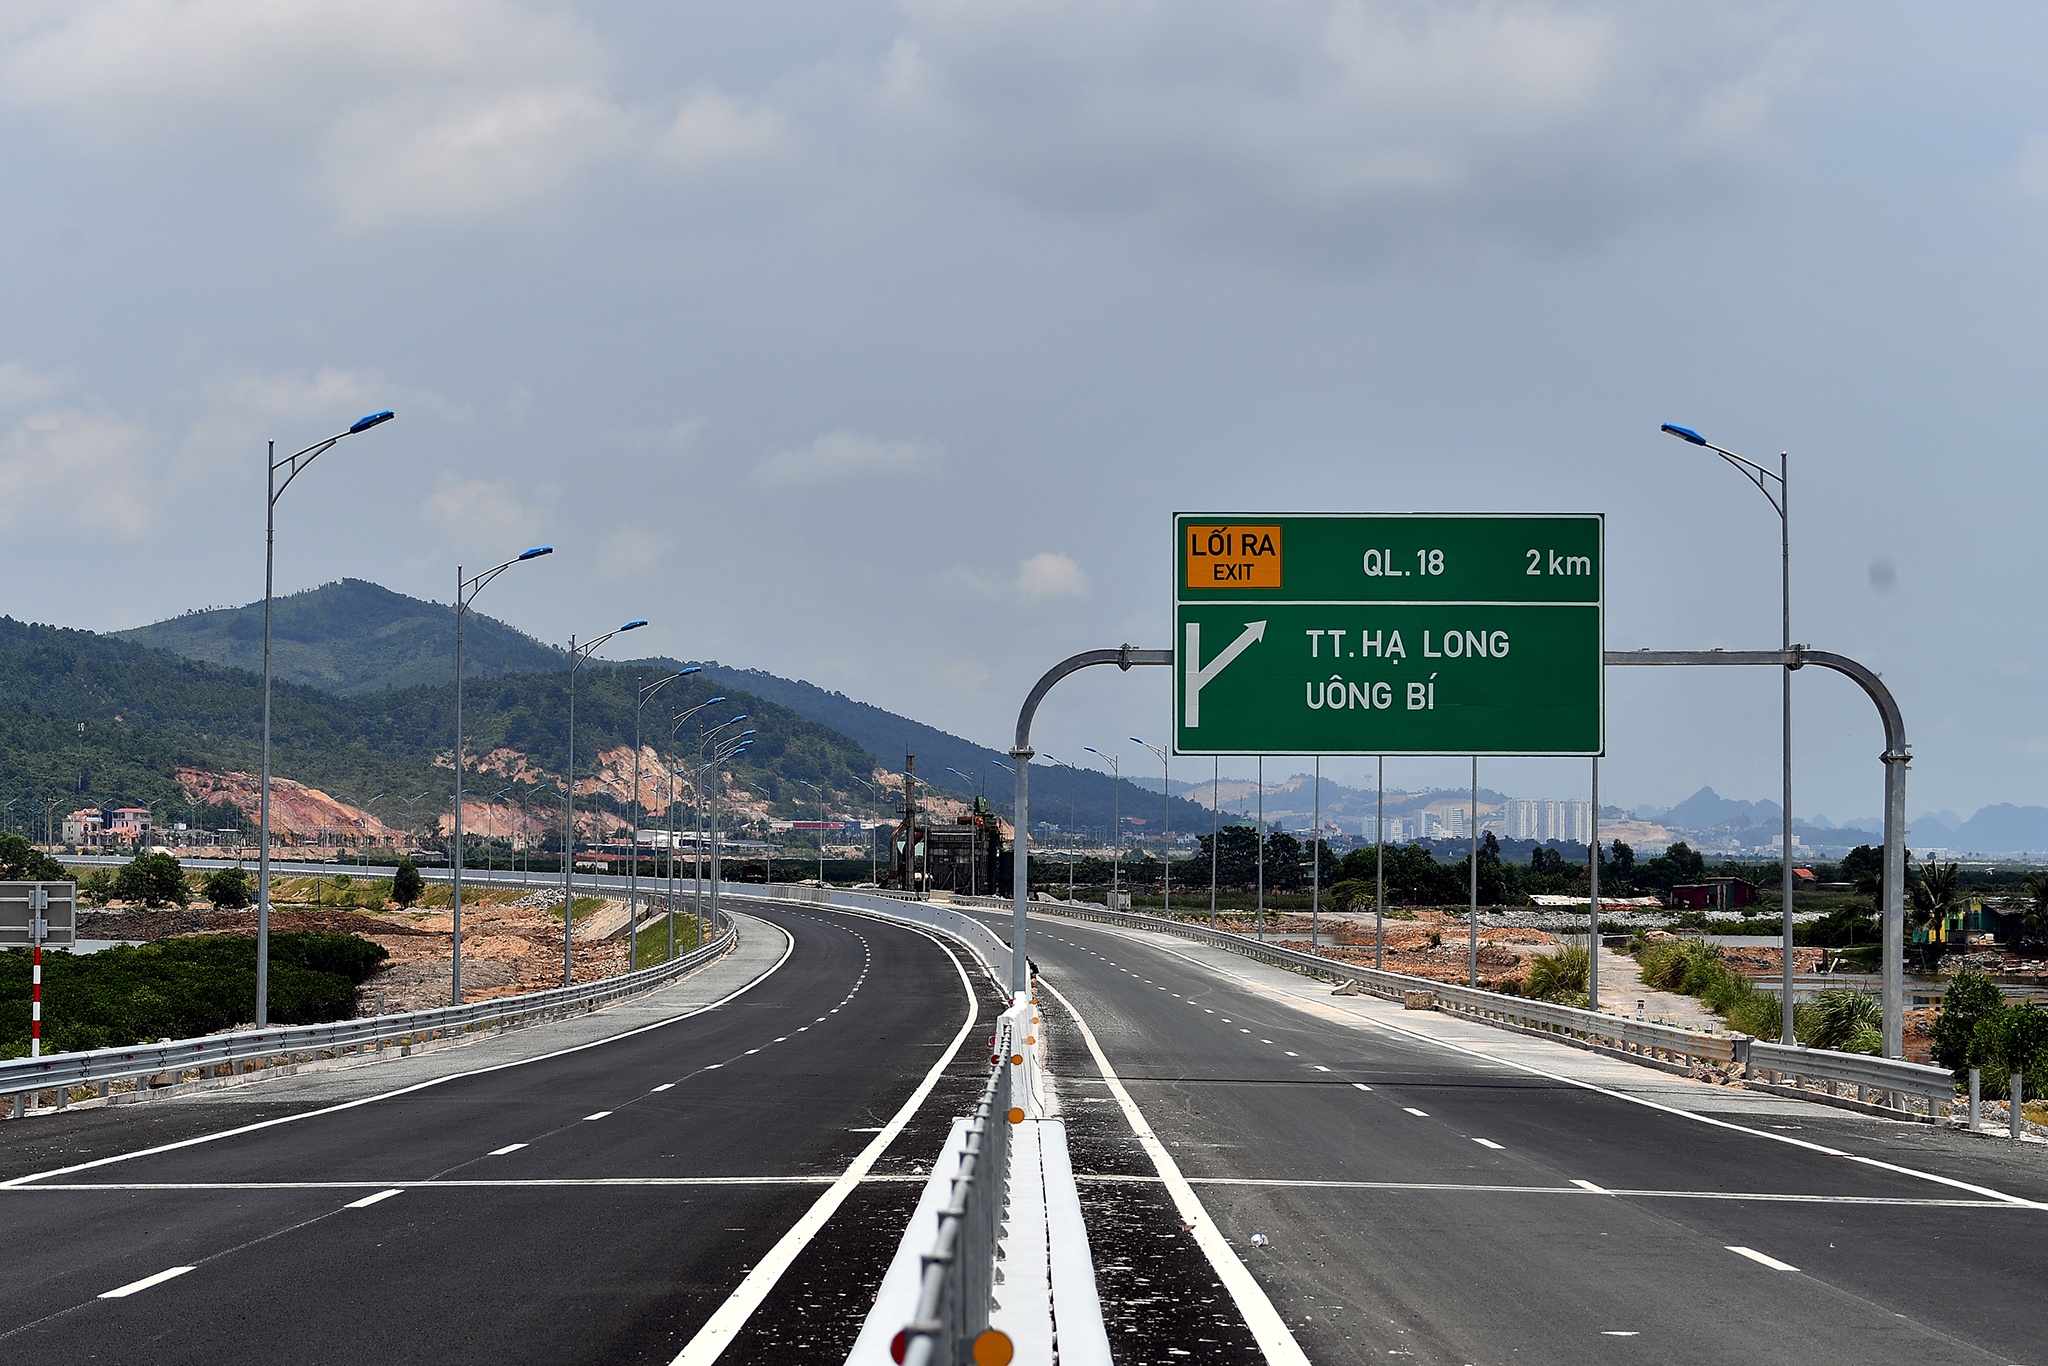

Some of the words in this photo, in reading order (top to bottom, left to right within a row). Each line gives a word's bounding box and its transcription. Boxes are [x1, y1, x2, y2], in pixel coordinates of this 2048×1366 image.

[1191, 527, 1232, 557] LỐI
[1241, 533, 1277, 557] RA
[1213, 563, 1255, 581] EXIT
[1526, 548, 1541, 576] 2
[1548, 549, 1591, 576] km
[1305, 629, 1407, 665] TT.HẠ
[1423, 630, 1510, 659] LONG
[1306, 674, 1392, 710] UÔNG
[1406, 672, 1438, 711] BÍ
